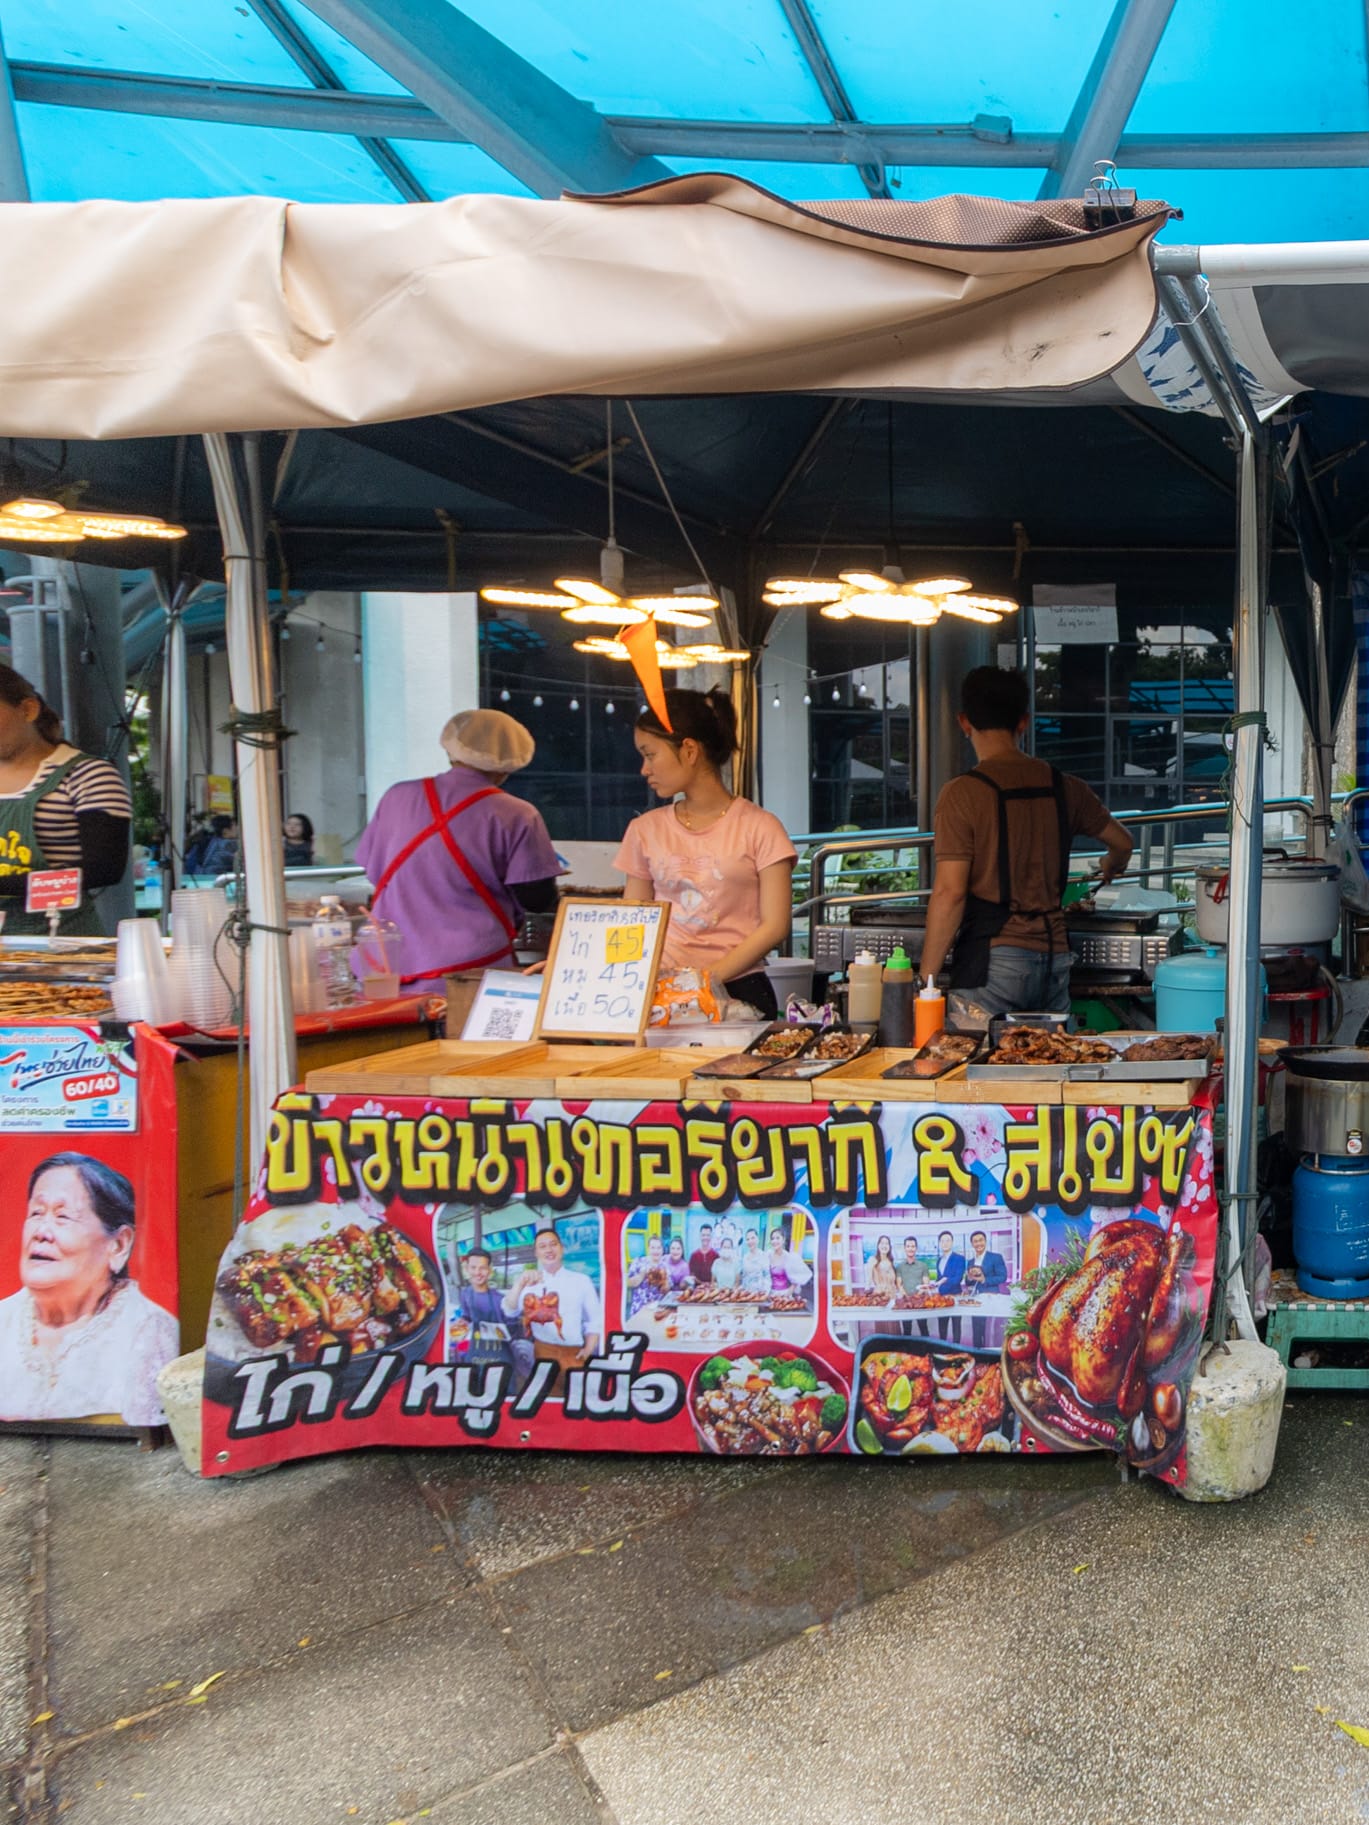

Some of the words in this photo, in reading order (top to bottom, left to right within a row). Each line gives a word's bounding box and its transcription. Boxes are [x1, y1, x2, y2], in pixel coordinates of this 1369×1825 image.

[65, 1074, 118, 1097] 60/40
[232, 1345, 345, 1430] ไก่
[404, 1364, 504, 1429] หมู
[564, 1335, 680, 1415] เนื้อ
